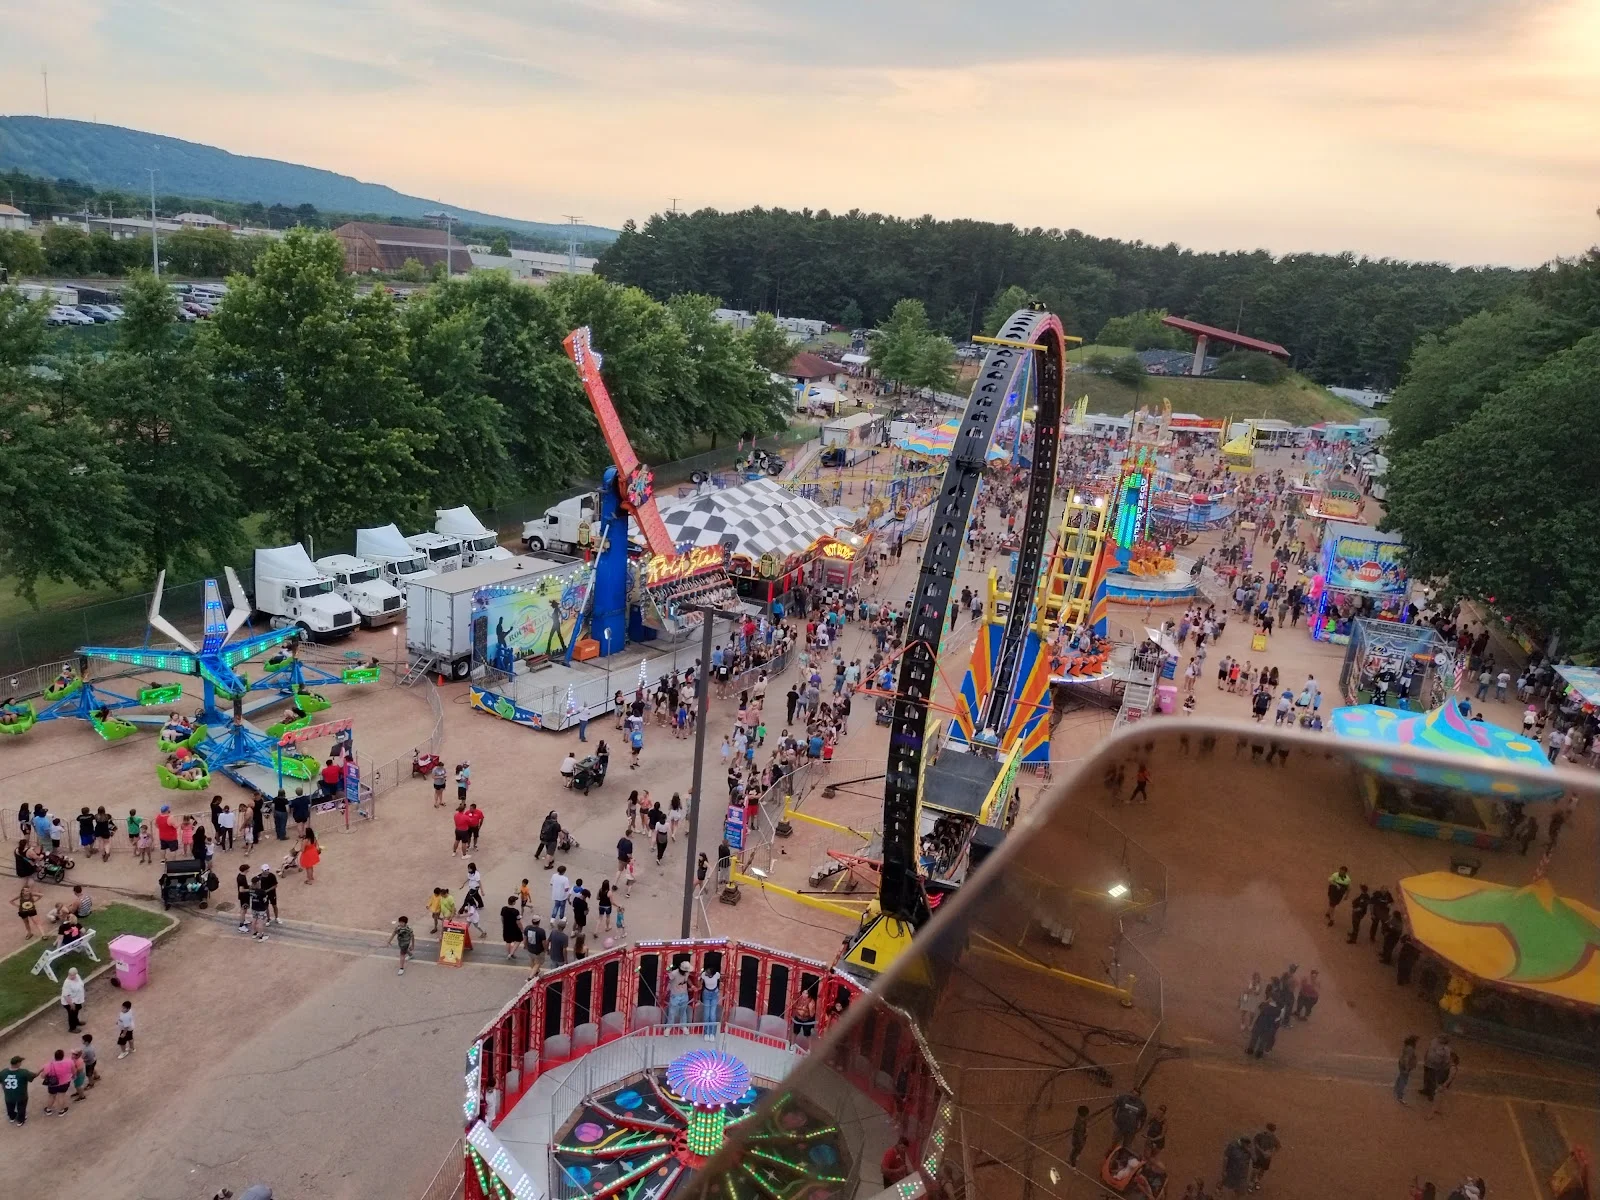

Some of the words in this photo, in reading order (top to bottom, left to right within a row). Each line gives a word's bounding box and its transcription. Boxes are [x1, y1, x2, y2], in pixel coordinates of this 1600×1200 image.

[1331, 490, 1361, 500] PIZZA
[1133, 478, 1147, 542] DOWNDRAFT
[823, 543, 837, 557] HOT
[1360, 567, 1382, 577] STOP
[4, 1078, 18, 1090] 33
